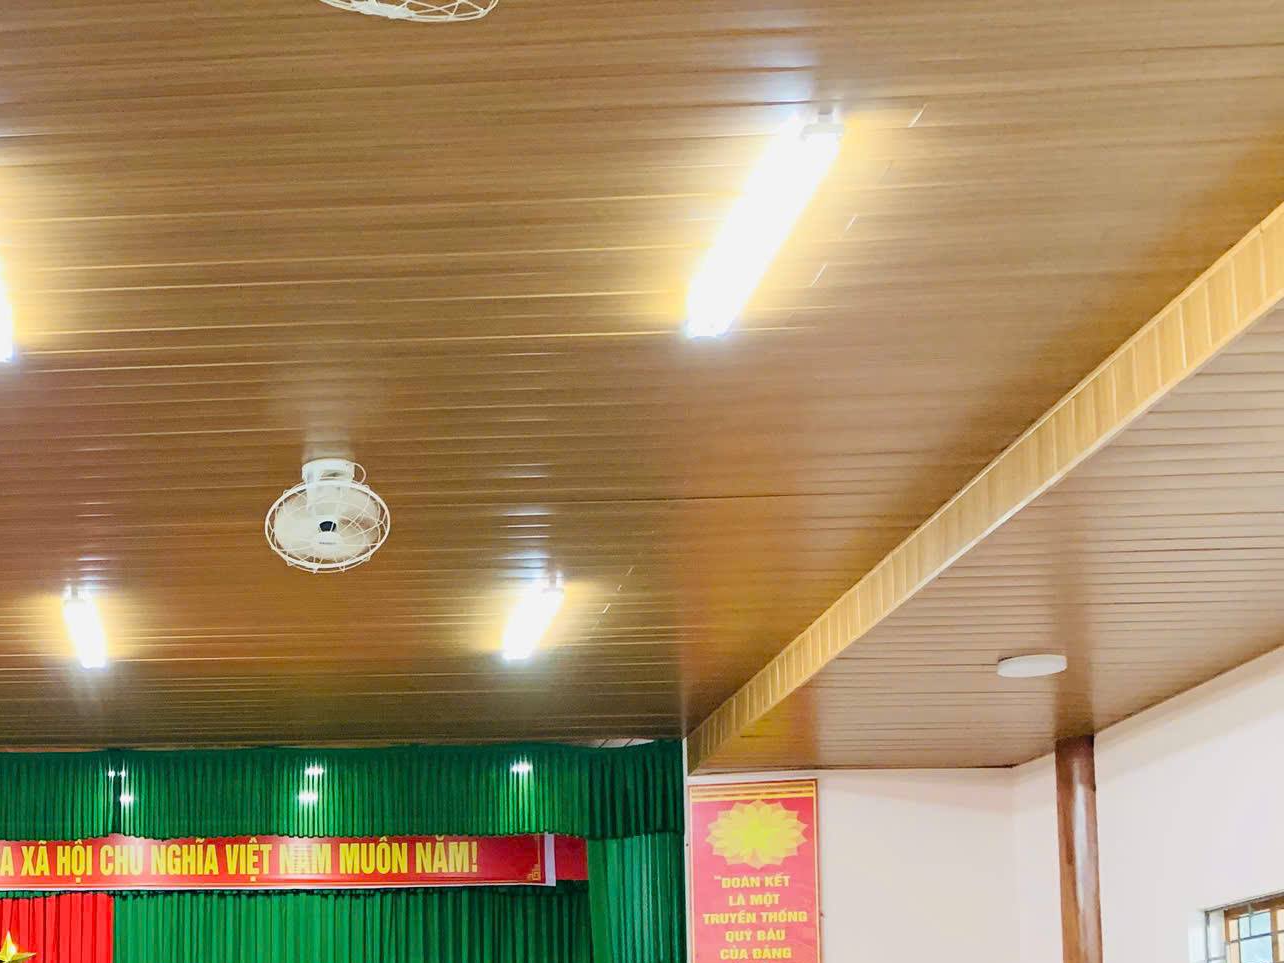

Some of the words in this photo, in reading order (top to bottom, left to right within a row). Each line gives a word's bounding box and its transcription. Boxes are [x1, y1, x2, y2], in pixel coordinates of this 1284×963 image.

[21, 840, 50, 876] XÃ
[56, 839, 93, 884] HỘI
[150, 838, 219, 876] NGHĨA
[226, 837, 272, 882] VIỆT
[279, 843, 332, 875] NAM
[339, 838, 408, 875] MUÔN
[416, 837, 478, 875] NĂM!
[764, 872, 791, 887] KẾT
[728, 894, 746, 906] LÀ
[749, 893, 781, 907] MỘT
